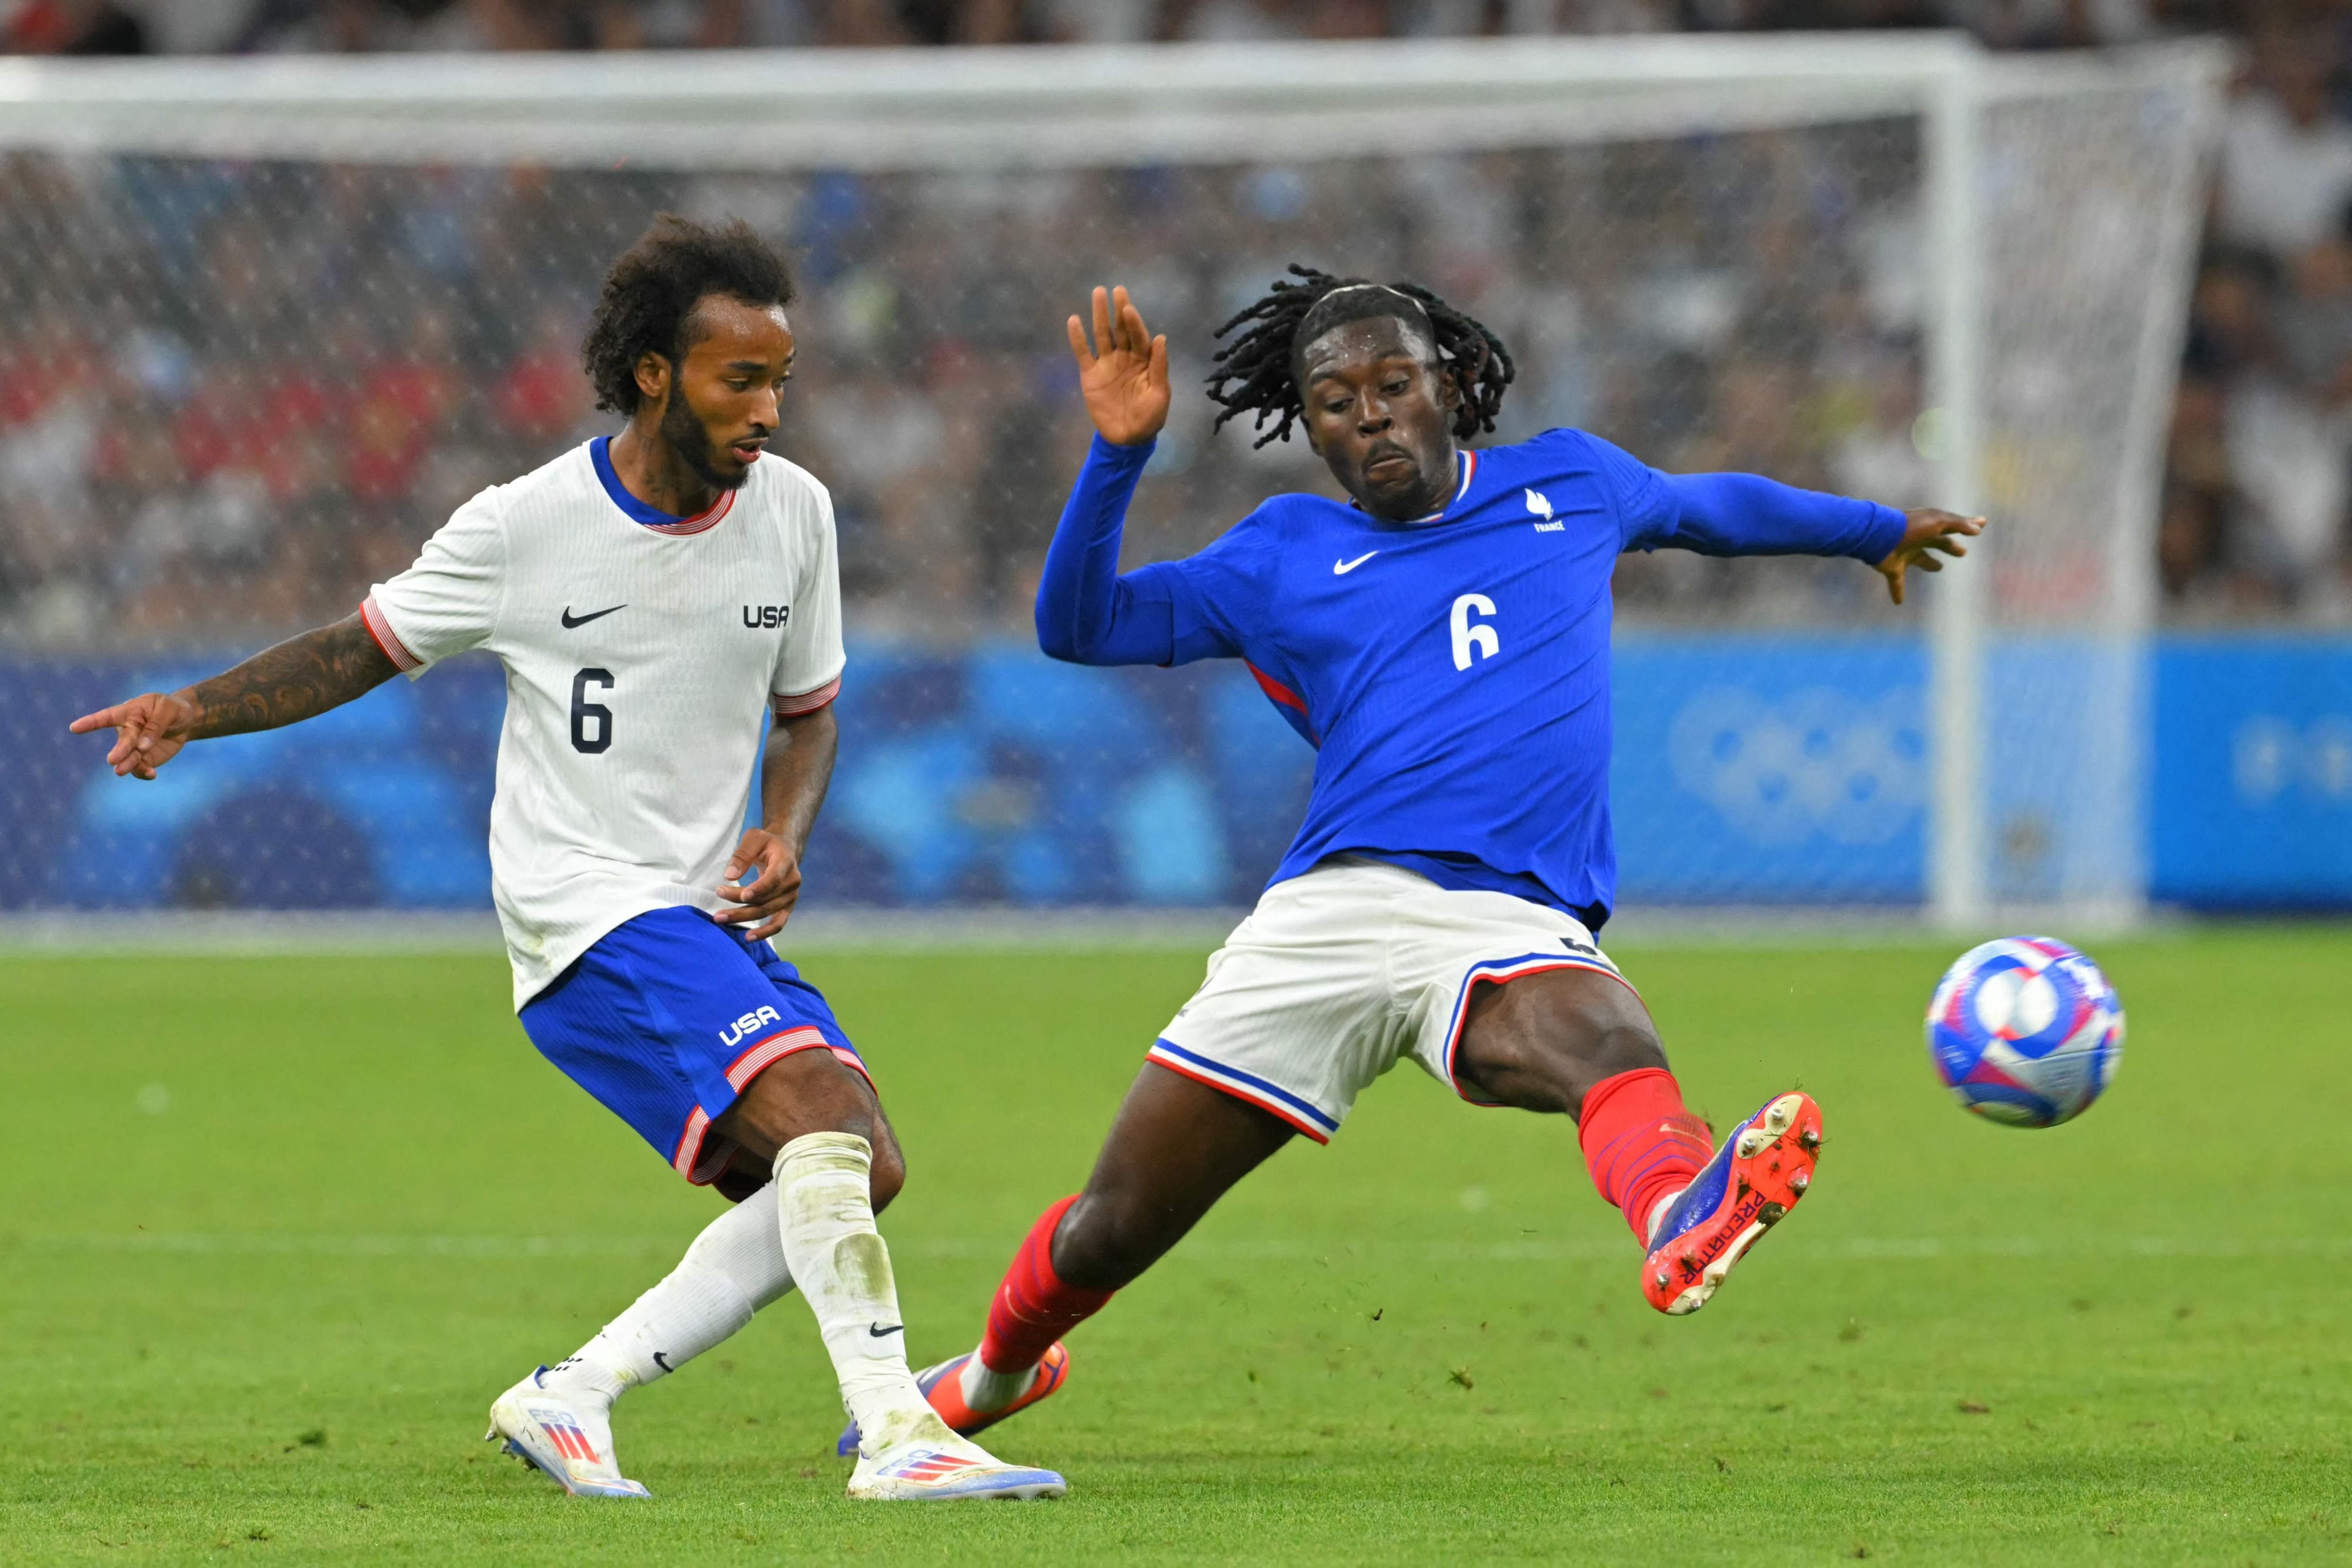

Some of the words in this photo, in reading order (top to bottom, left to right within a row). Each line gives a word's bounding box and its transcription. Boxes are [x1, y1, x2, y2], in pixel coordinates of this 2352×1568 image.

[1534, 520, 1566, 533] FRANCE
[743, 605, 789, 628] USA
[1450, 593, 1499, 671] 6
[571, 668, 614, 754] 6
[719, 1005, 781, 1046] USA
[1679, 1190, 1766, 1285] PREDATOR
